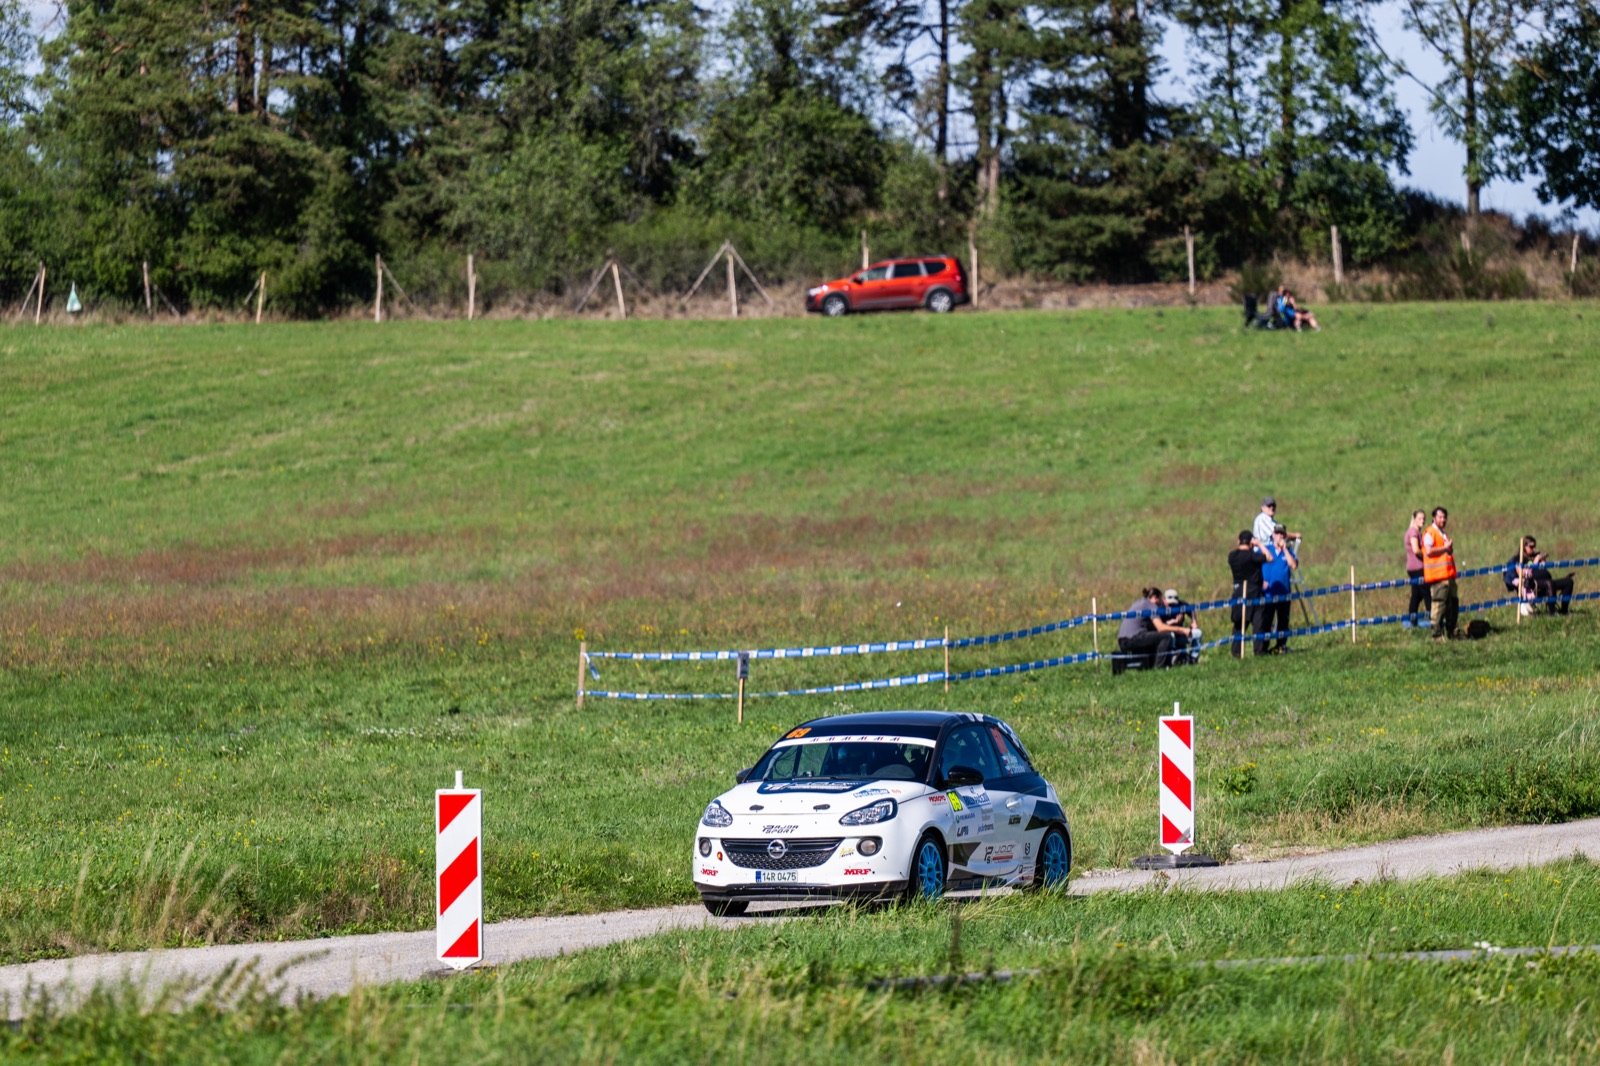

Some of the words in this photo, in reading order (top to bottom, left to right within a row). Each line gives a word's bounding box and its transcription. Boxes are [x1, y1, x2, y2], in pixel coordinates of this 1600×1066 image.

[700, 868, 719, 876] MRF
[762, 872, 776, 881] 14R
[777, 872, 797, 881] 0475
